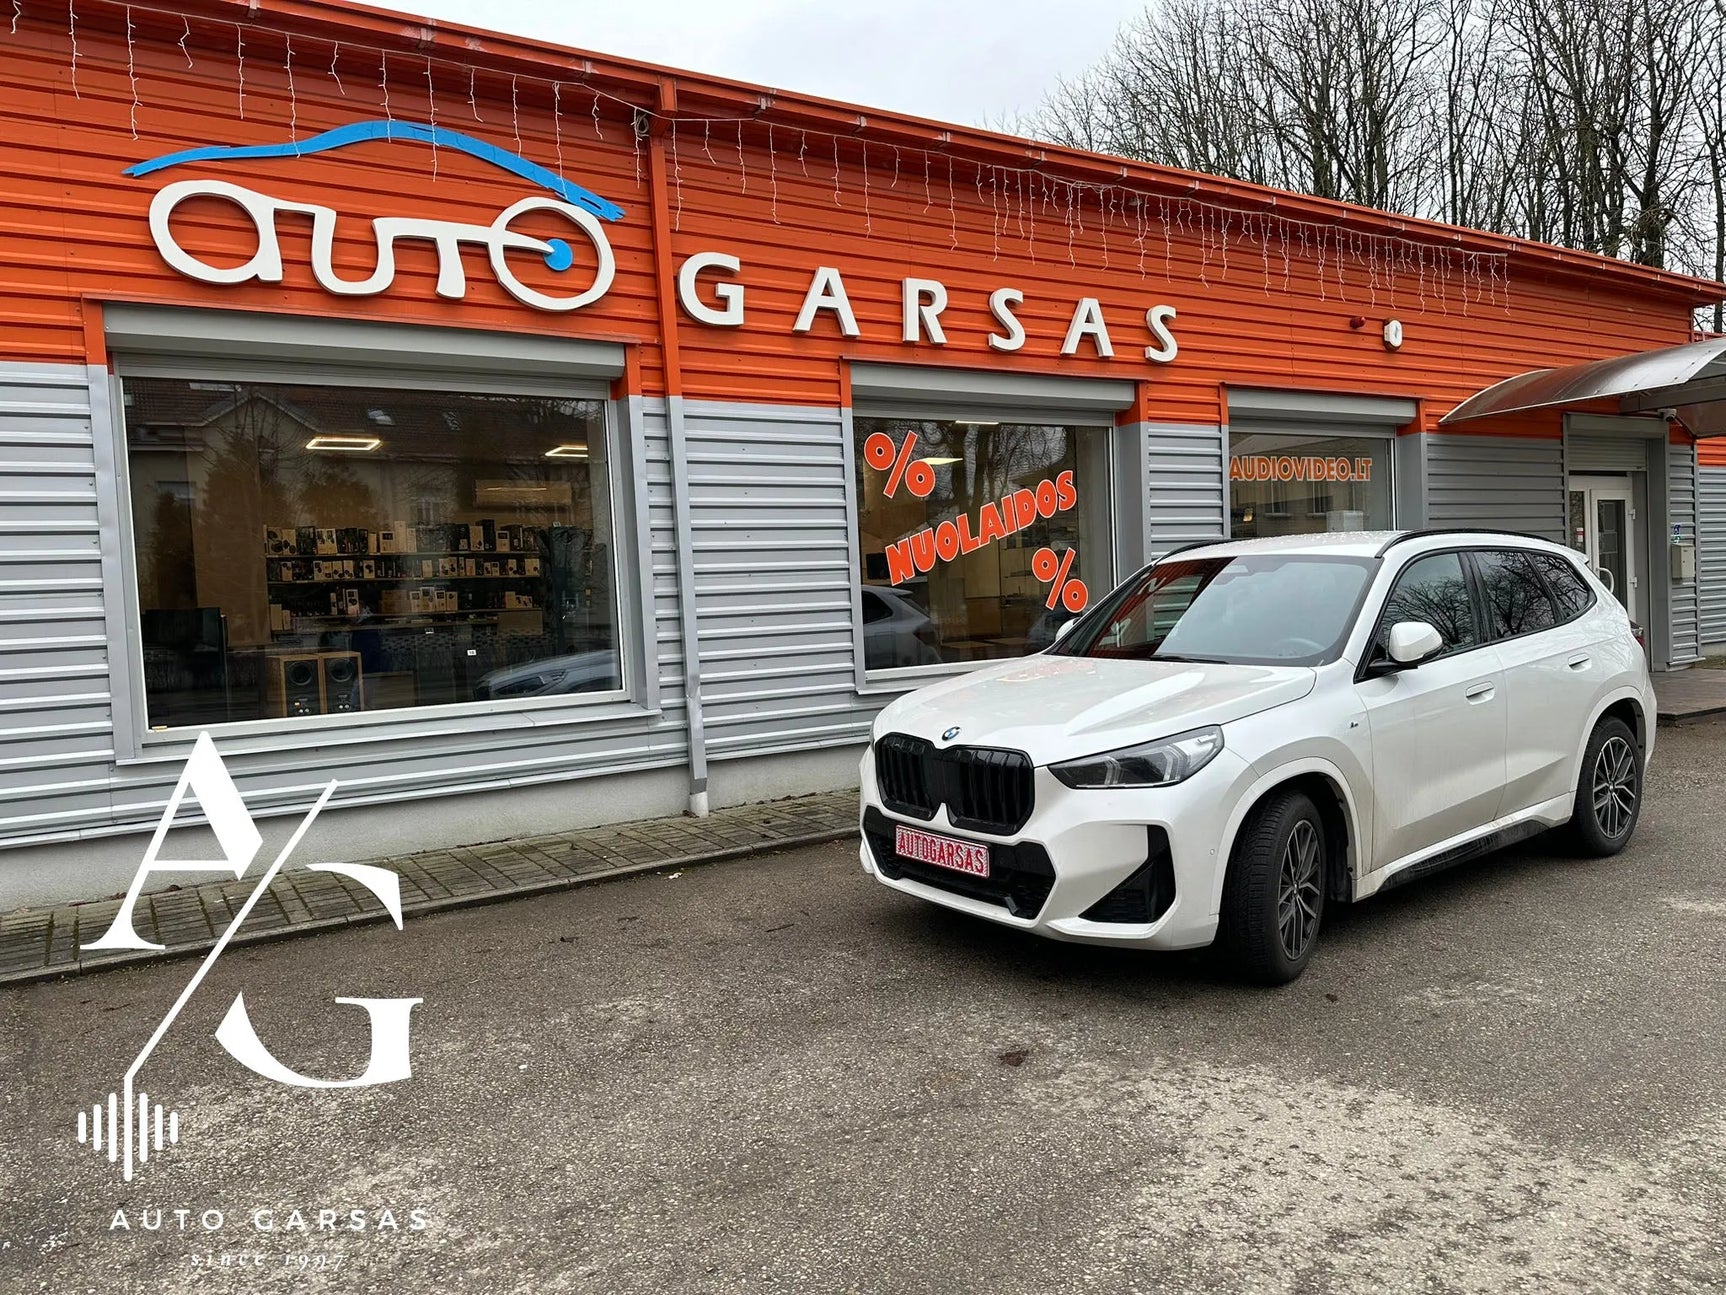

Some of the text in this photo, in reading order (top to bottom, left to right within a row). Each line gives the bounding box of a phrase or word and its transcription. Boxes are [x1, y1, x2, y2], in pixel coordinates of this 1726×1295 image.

[677, 251, 1180, 364] GARSAS
[863, 430, 936, 499] %
[1229, 456, 1373, 482] AUDIOVIDEO.LT
[884, 469, 1078, 587] NUOLAIDOS
[1031, 546, 1090, 614] %
[897, 832, 985, 874] AUTOGARSAS
